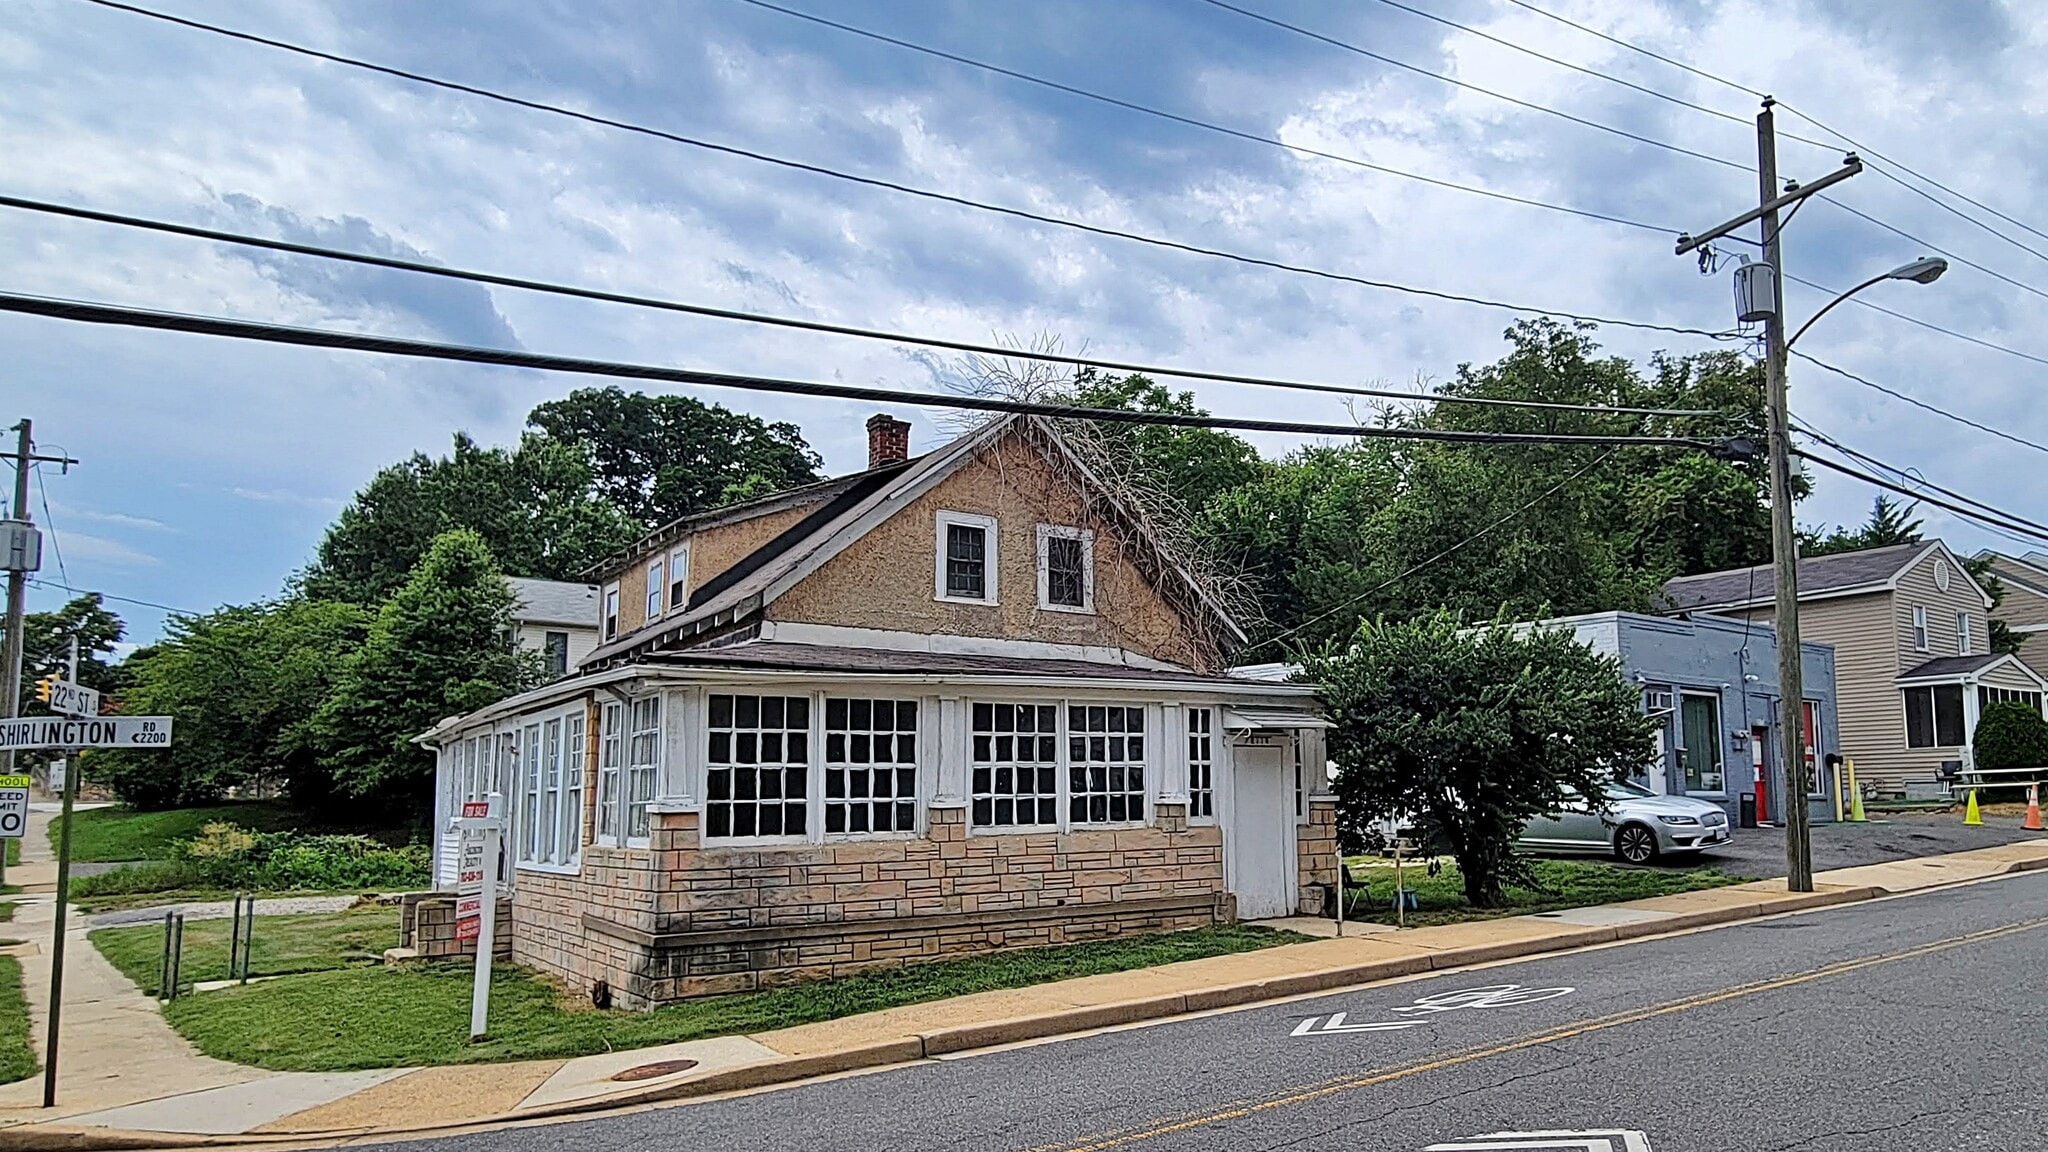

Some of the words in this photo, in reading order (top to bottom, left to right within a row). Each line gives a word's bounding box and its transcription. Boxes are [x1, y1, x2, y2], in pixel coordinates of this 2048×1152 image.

[77, 691, 90, 714] ST
[0, 721, 117, 746] SHIRLINGTON
[142, 721, 156, 733] RD
[464, 806, 474, 817] FOR
[475, 805, 487, 816] SALE
